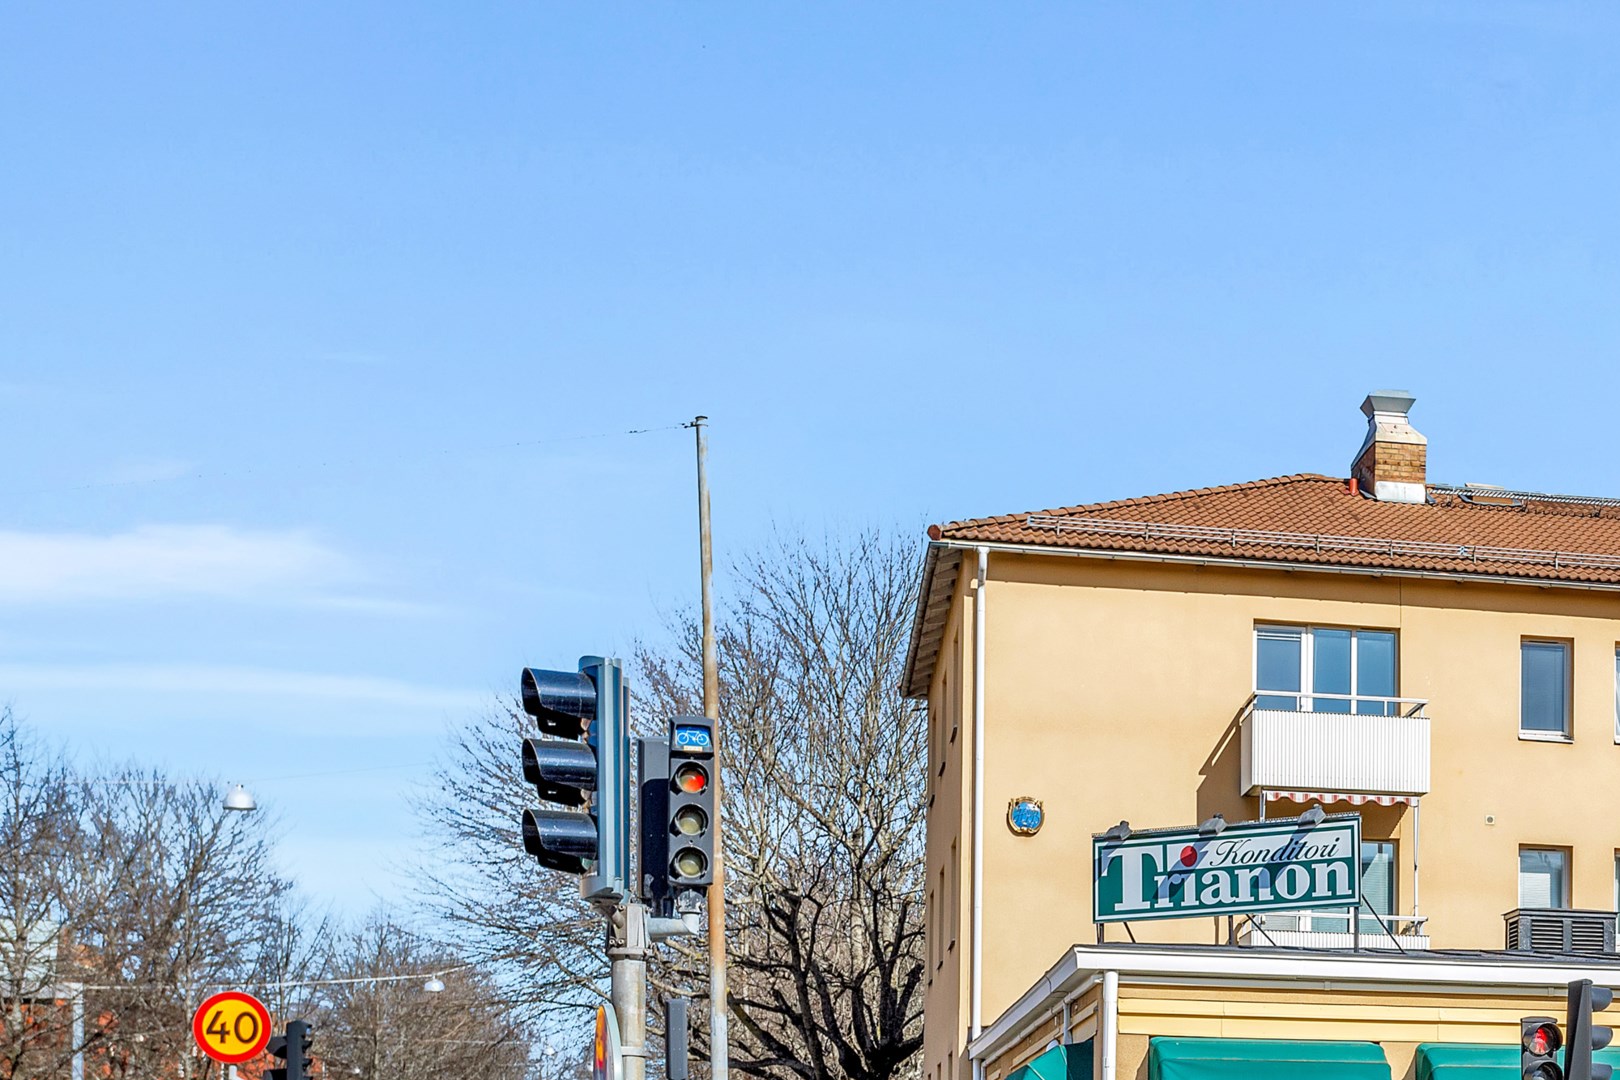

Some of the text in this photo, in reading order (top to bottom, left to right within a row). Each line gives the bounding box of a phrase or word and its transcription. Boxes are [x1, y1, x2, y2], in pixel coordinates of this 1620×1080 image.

[1210, 837, 1340, 867] Konditori
[1100, 845, 1352, 911] Trianon
[206, 1010, 259, 1044] 40
